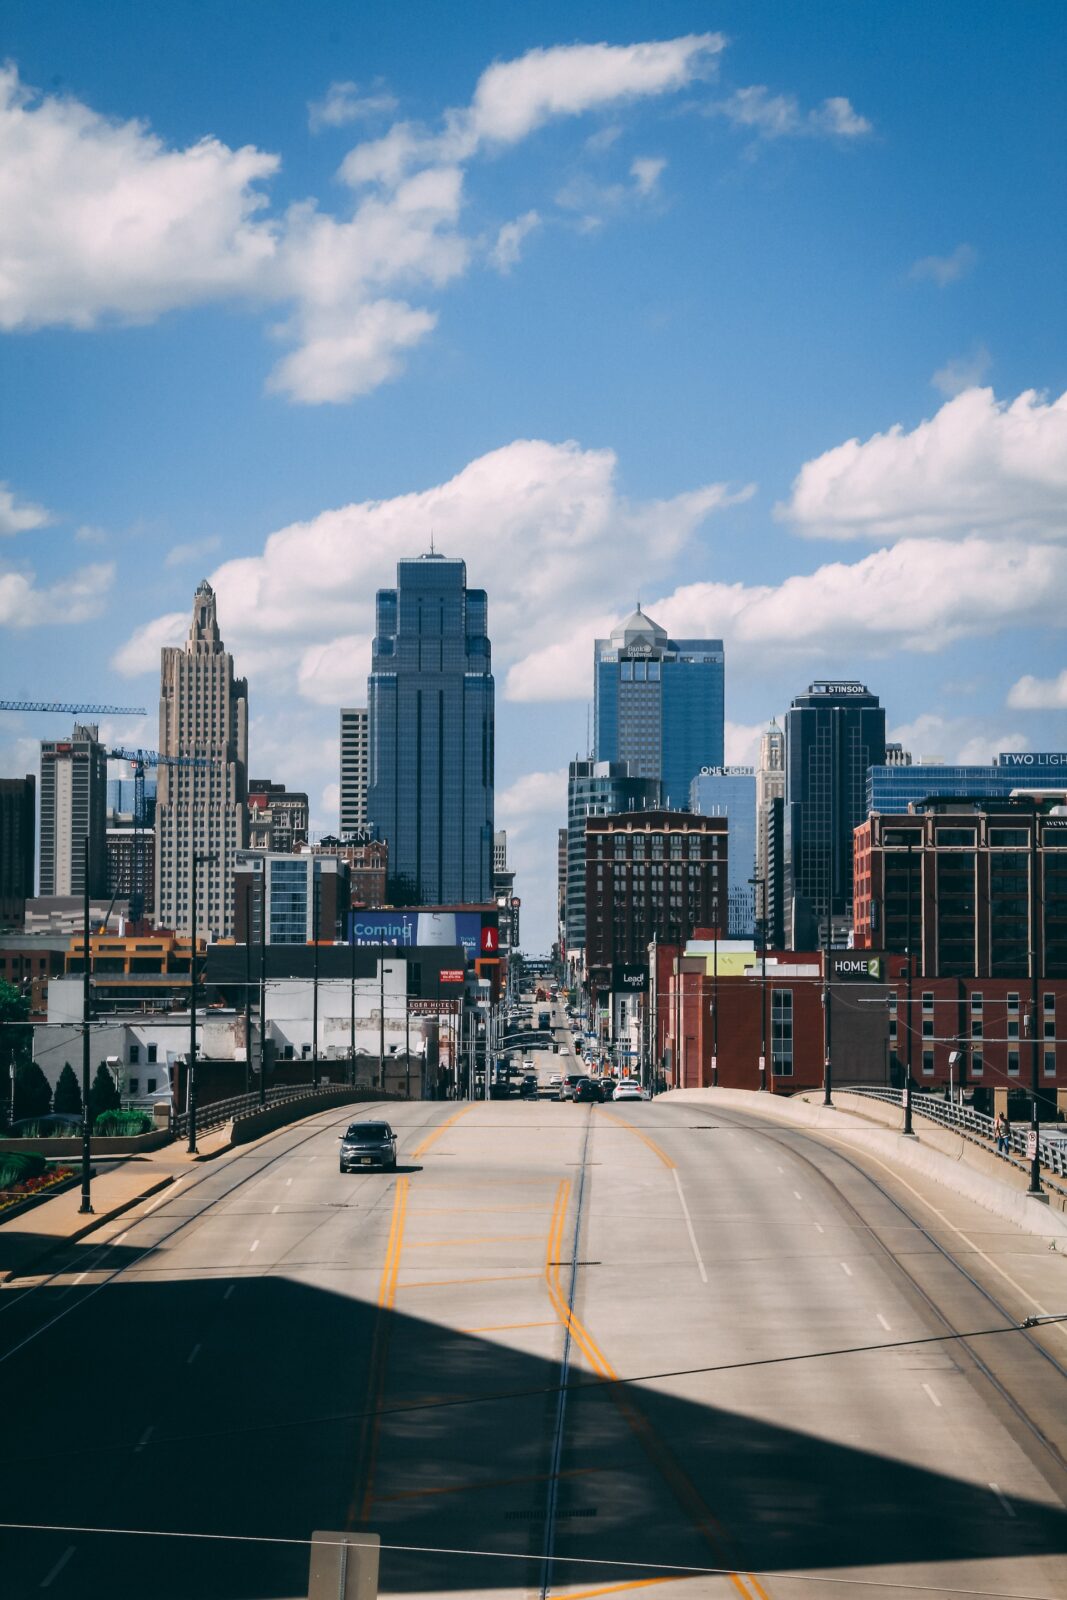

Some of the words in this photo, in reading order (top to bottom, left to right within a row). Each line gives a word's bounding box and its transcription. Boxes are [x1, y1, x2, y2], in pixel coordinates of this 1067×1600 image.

[1003, 754, 1034, 765] TWO
[700, 766, 721, 775] ONE
[721, 766, 754, 775] LIGHT
[353, 923, 411, 938] Coming
